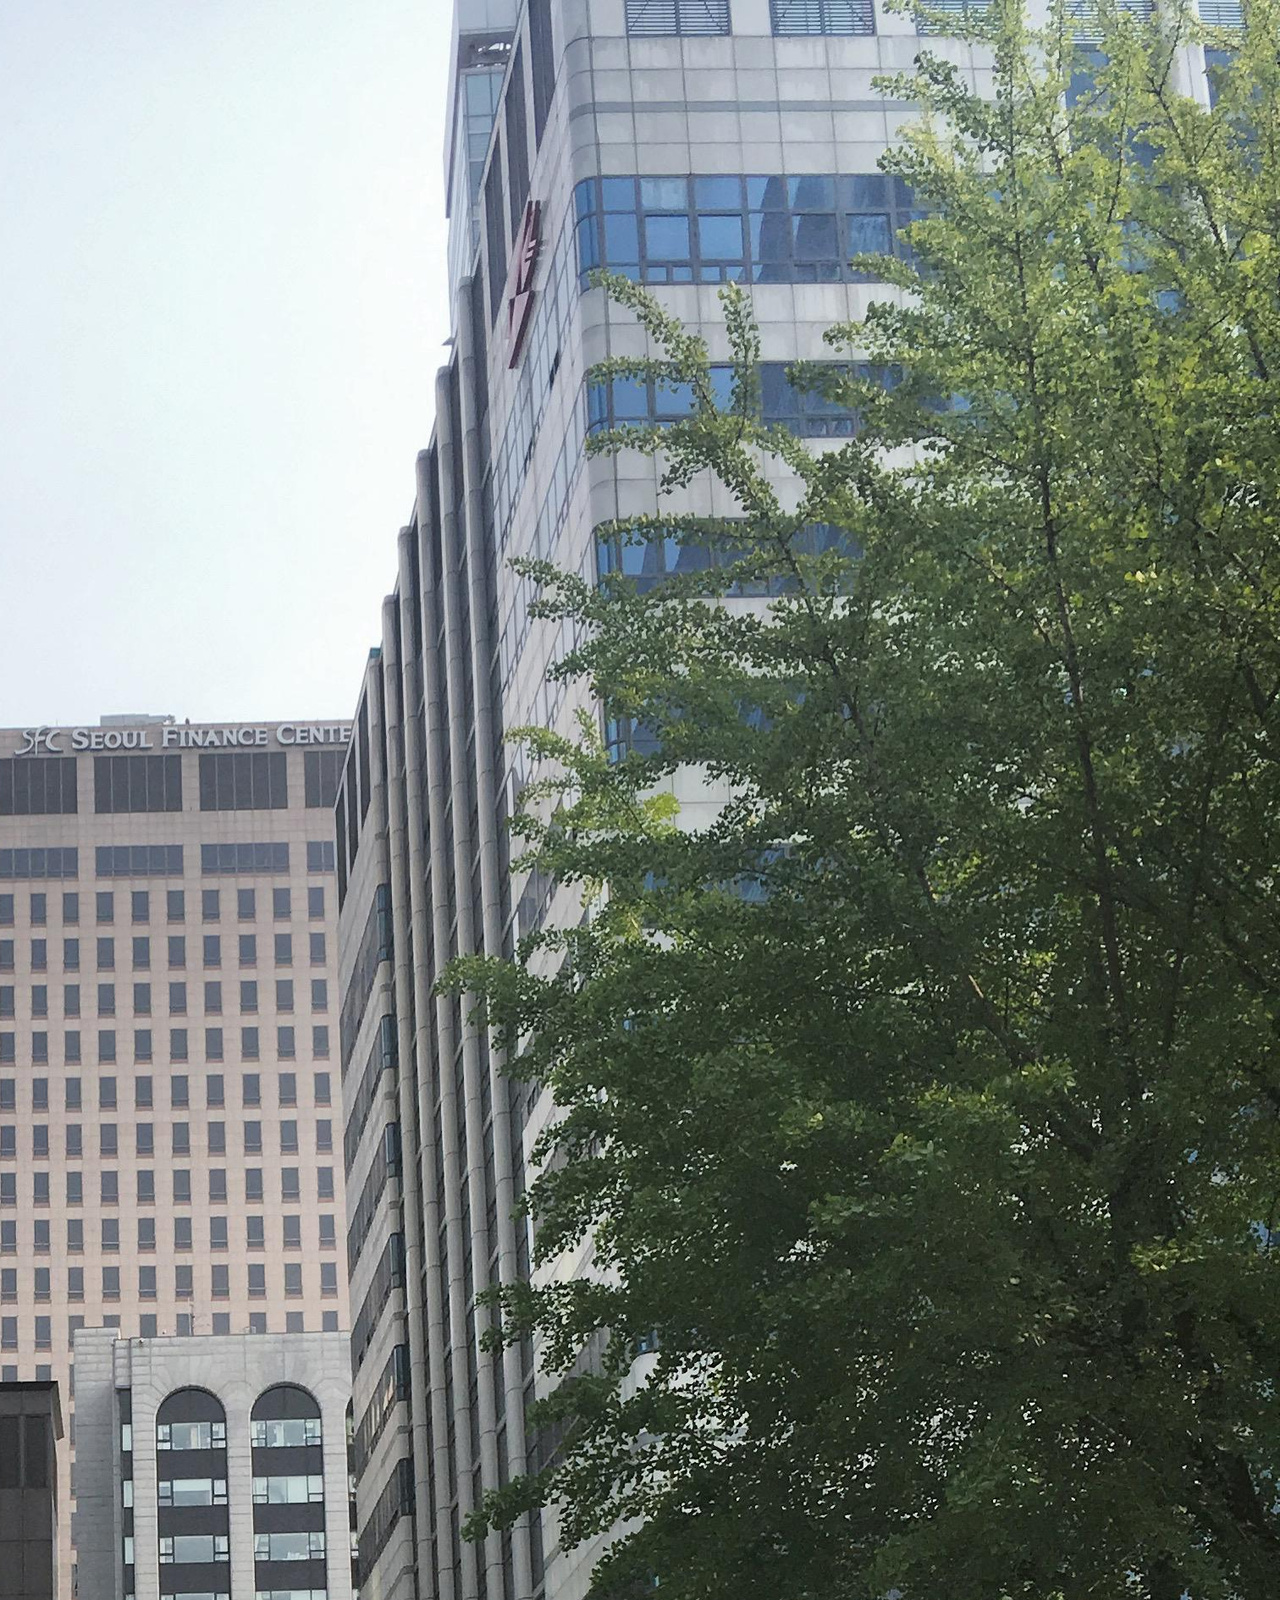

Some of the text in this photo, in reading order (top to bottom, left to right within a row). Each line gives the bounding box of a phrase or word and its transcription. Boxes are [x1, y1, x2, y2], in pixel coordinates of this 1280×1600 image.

[71, 727, 154, 751] SEOUL
[162, 726, 269, 748] FINANCE
[276, 722, 353, 745] CENTE
